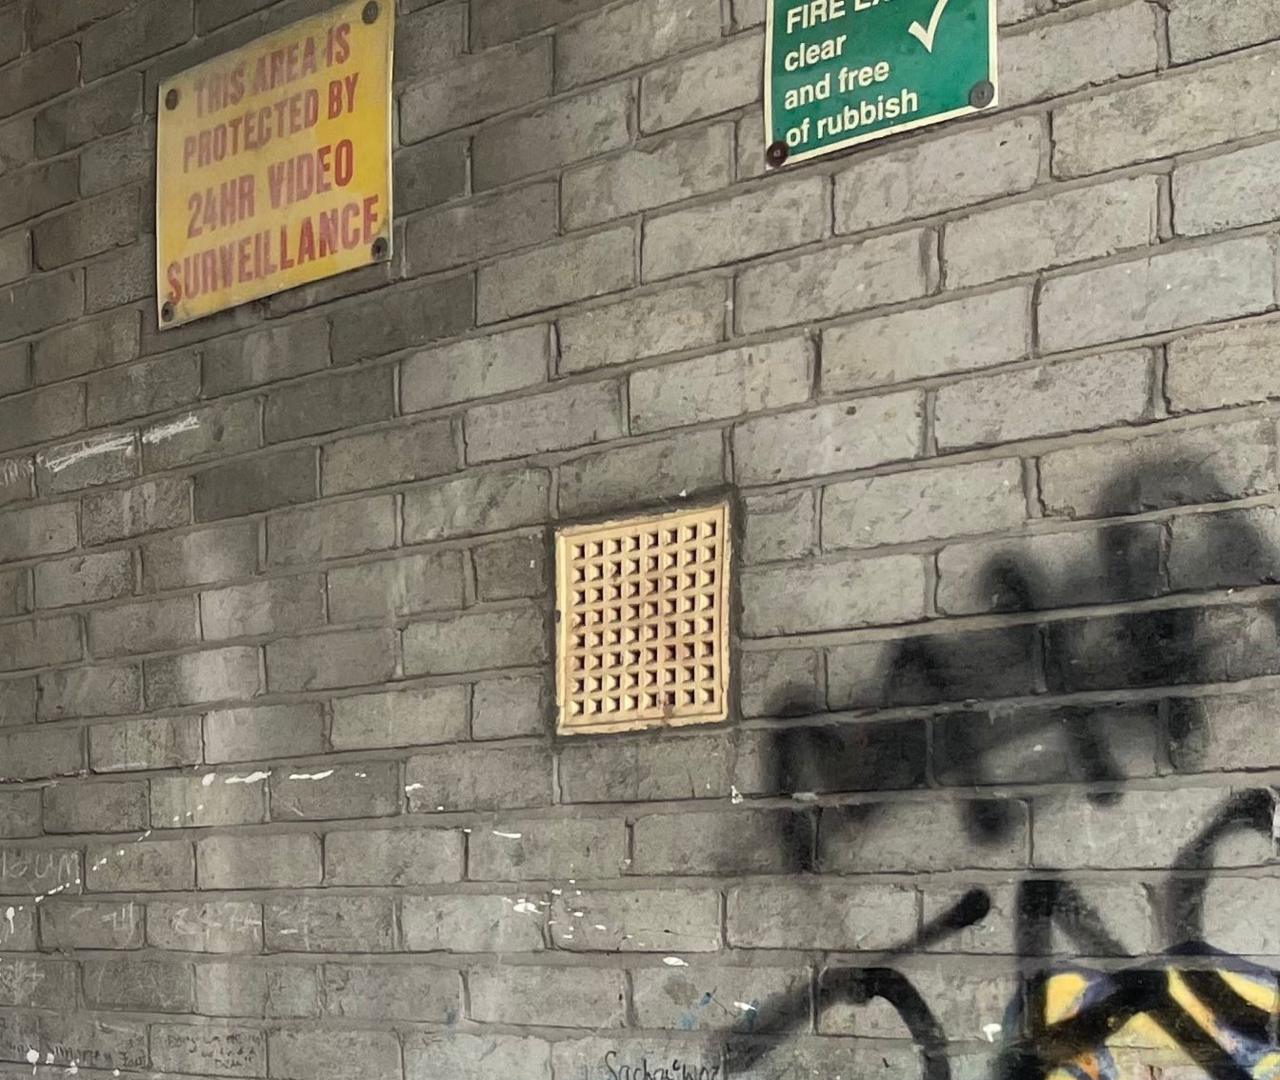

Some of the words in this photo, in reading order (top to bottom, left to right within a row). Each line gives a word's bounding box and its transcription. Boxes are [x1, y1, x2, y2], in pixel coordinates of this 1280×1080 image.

[784, 34, 847, 71] clear
[786, 0, 846, 34] FIRE
[194, 62, 245, 118] THIS
[252, 36, 317, 93] AREA
[325, 22, 351, 67] IS
[784, 73, 831, 110] and
[838, 60, 890, 93] free
[183, 87, 319, 173] PROTECTED
[328, 72, 359, 120] BY
[786, 123, 811, 147] of
[817, 88, 918, 139] rubbish
[186, 173, 256, 239] 24HR
[267, 139, 354, 210] VIDEO
[167, 194, 379, 306] SURVEILLANCE
